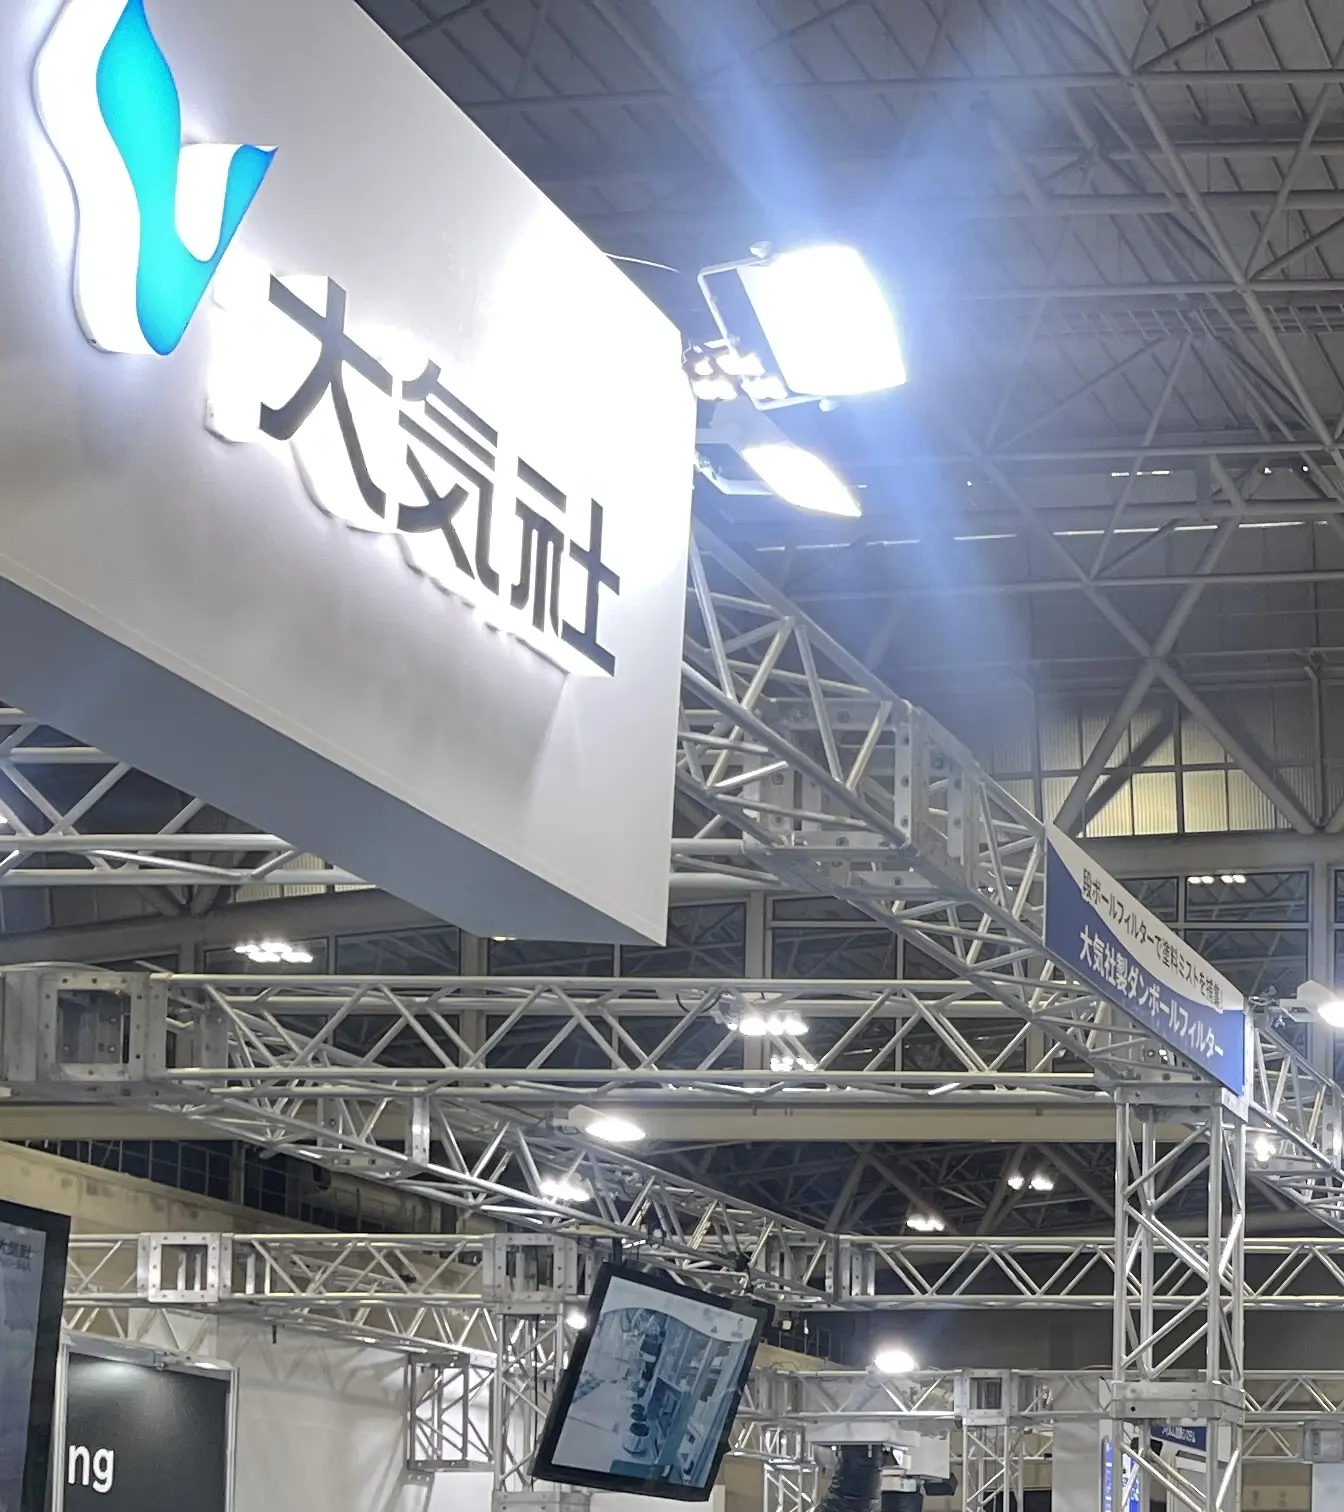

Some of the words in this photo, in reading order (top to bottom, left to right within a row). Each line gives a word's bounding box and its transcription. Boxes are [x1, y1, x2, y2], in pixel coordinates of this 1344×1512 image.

[259, 273, 621, 677] 大気社
[1079, 924, 1224, 1059] 大気社製ダンボールフィルター
[67, 1443, 116, 1493] ng
